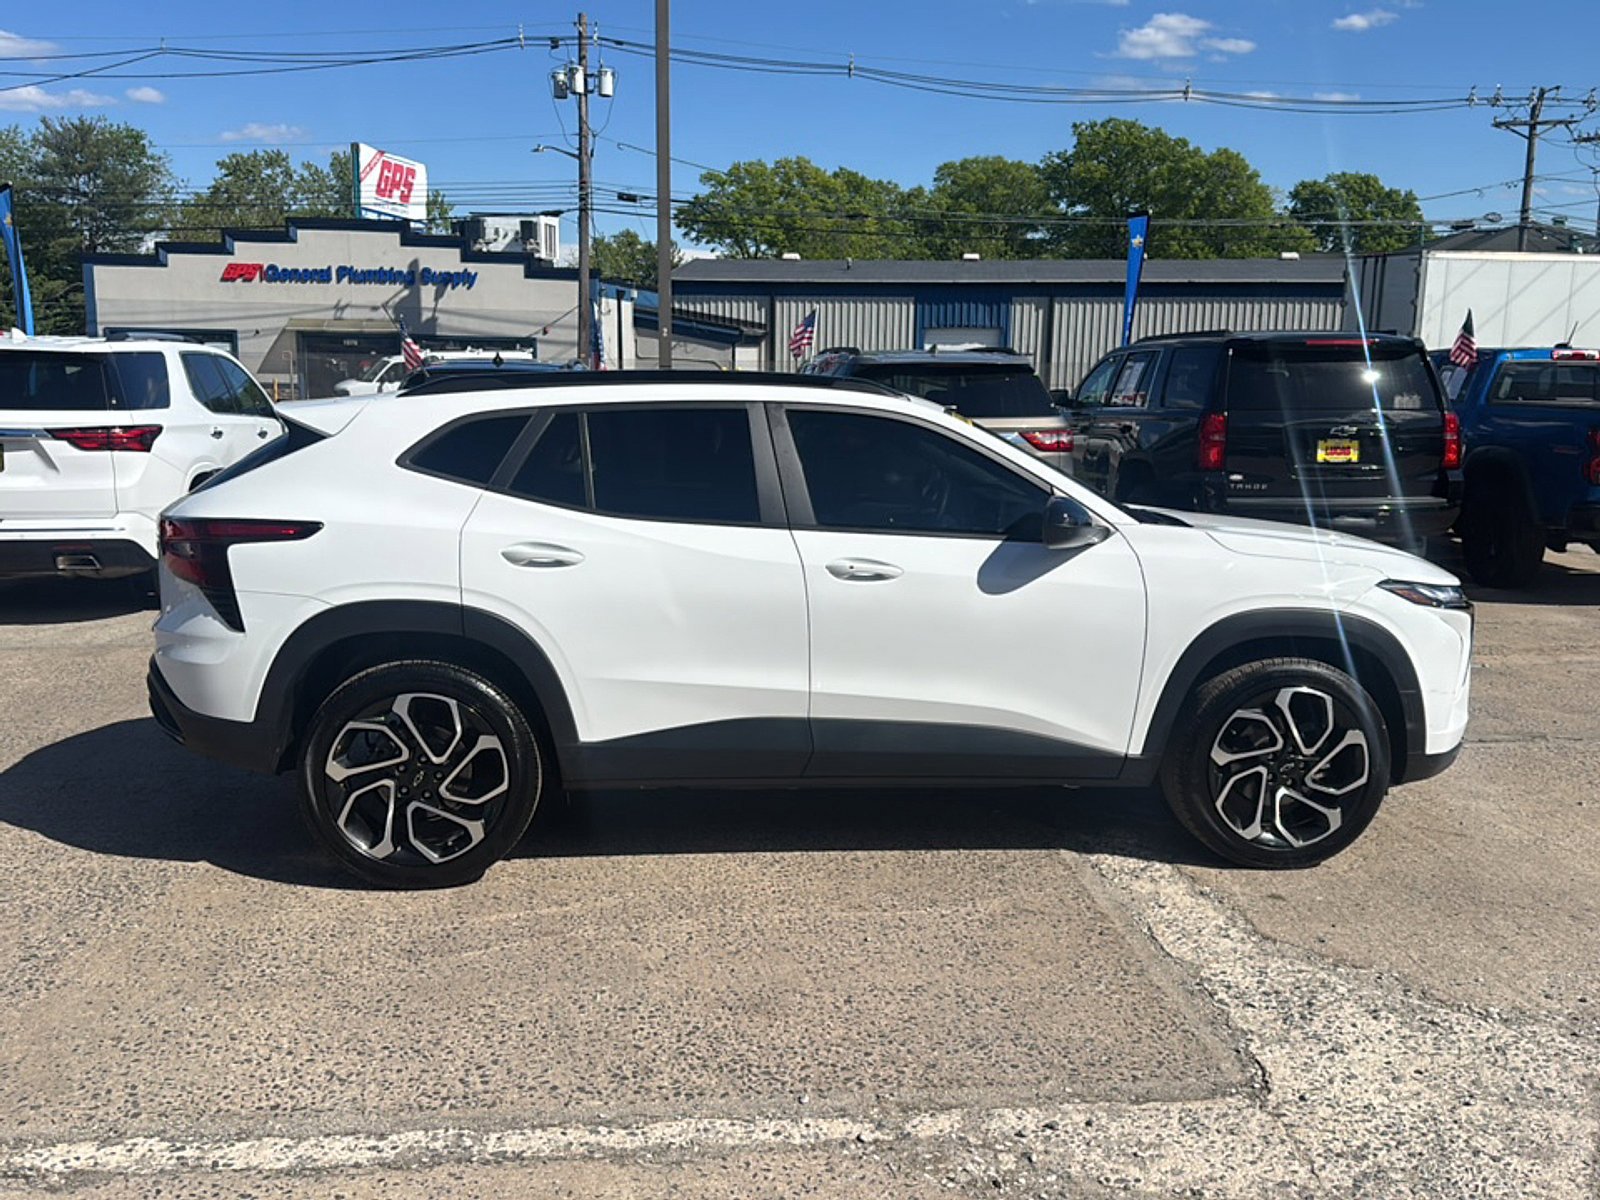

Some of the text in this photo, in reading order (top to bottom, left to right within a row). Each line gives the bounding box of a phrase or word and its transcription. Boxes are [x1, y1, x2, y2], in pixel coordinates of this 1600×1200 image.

[376, 159, 416, 204] GPS
[220, 263, 478, 291] GPS General Plumbing Supply
